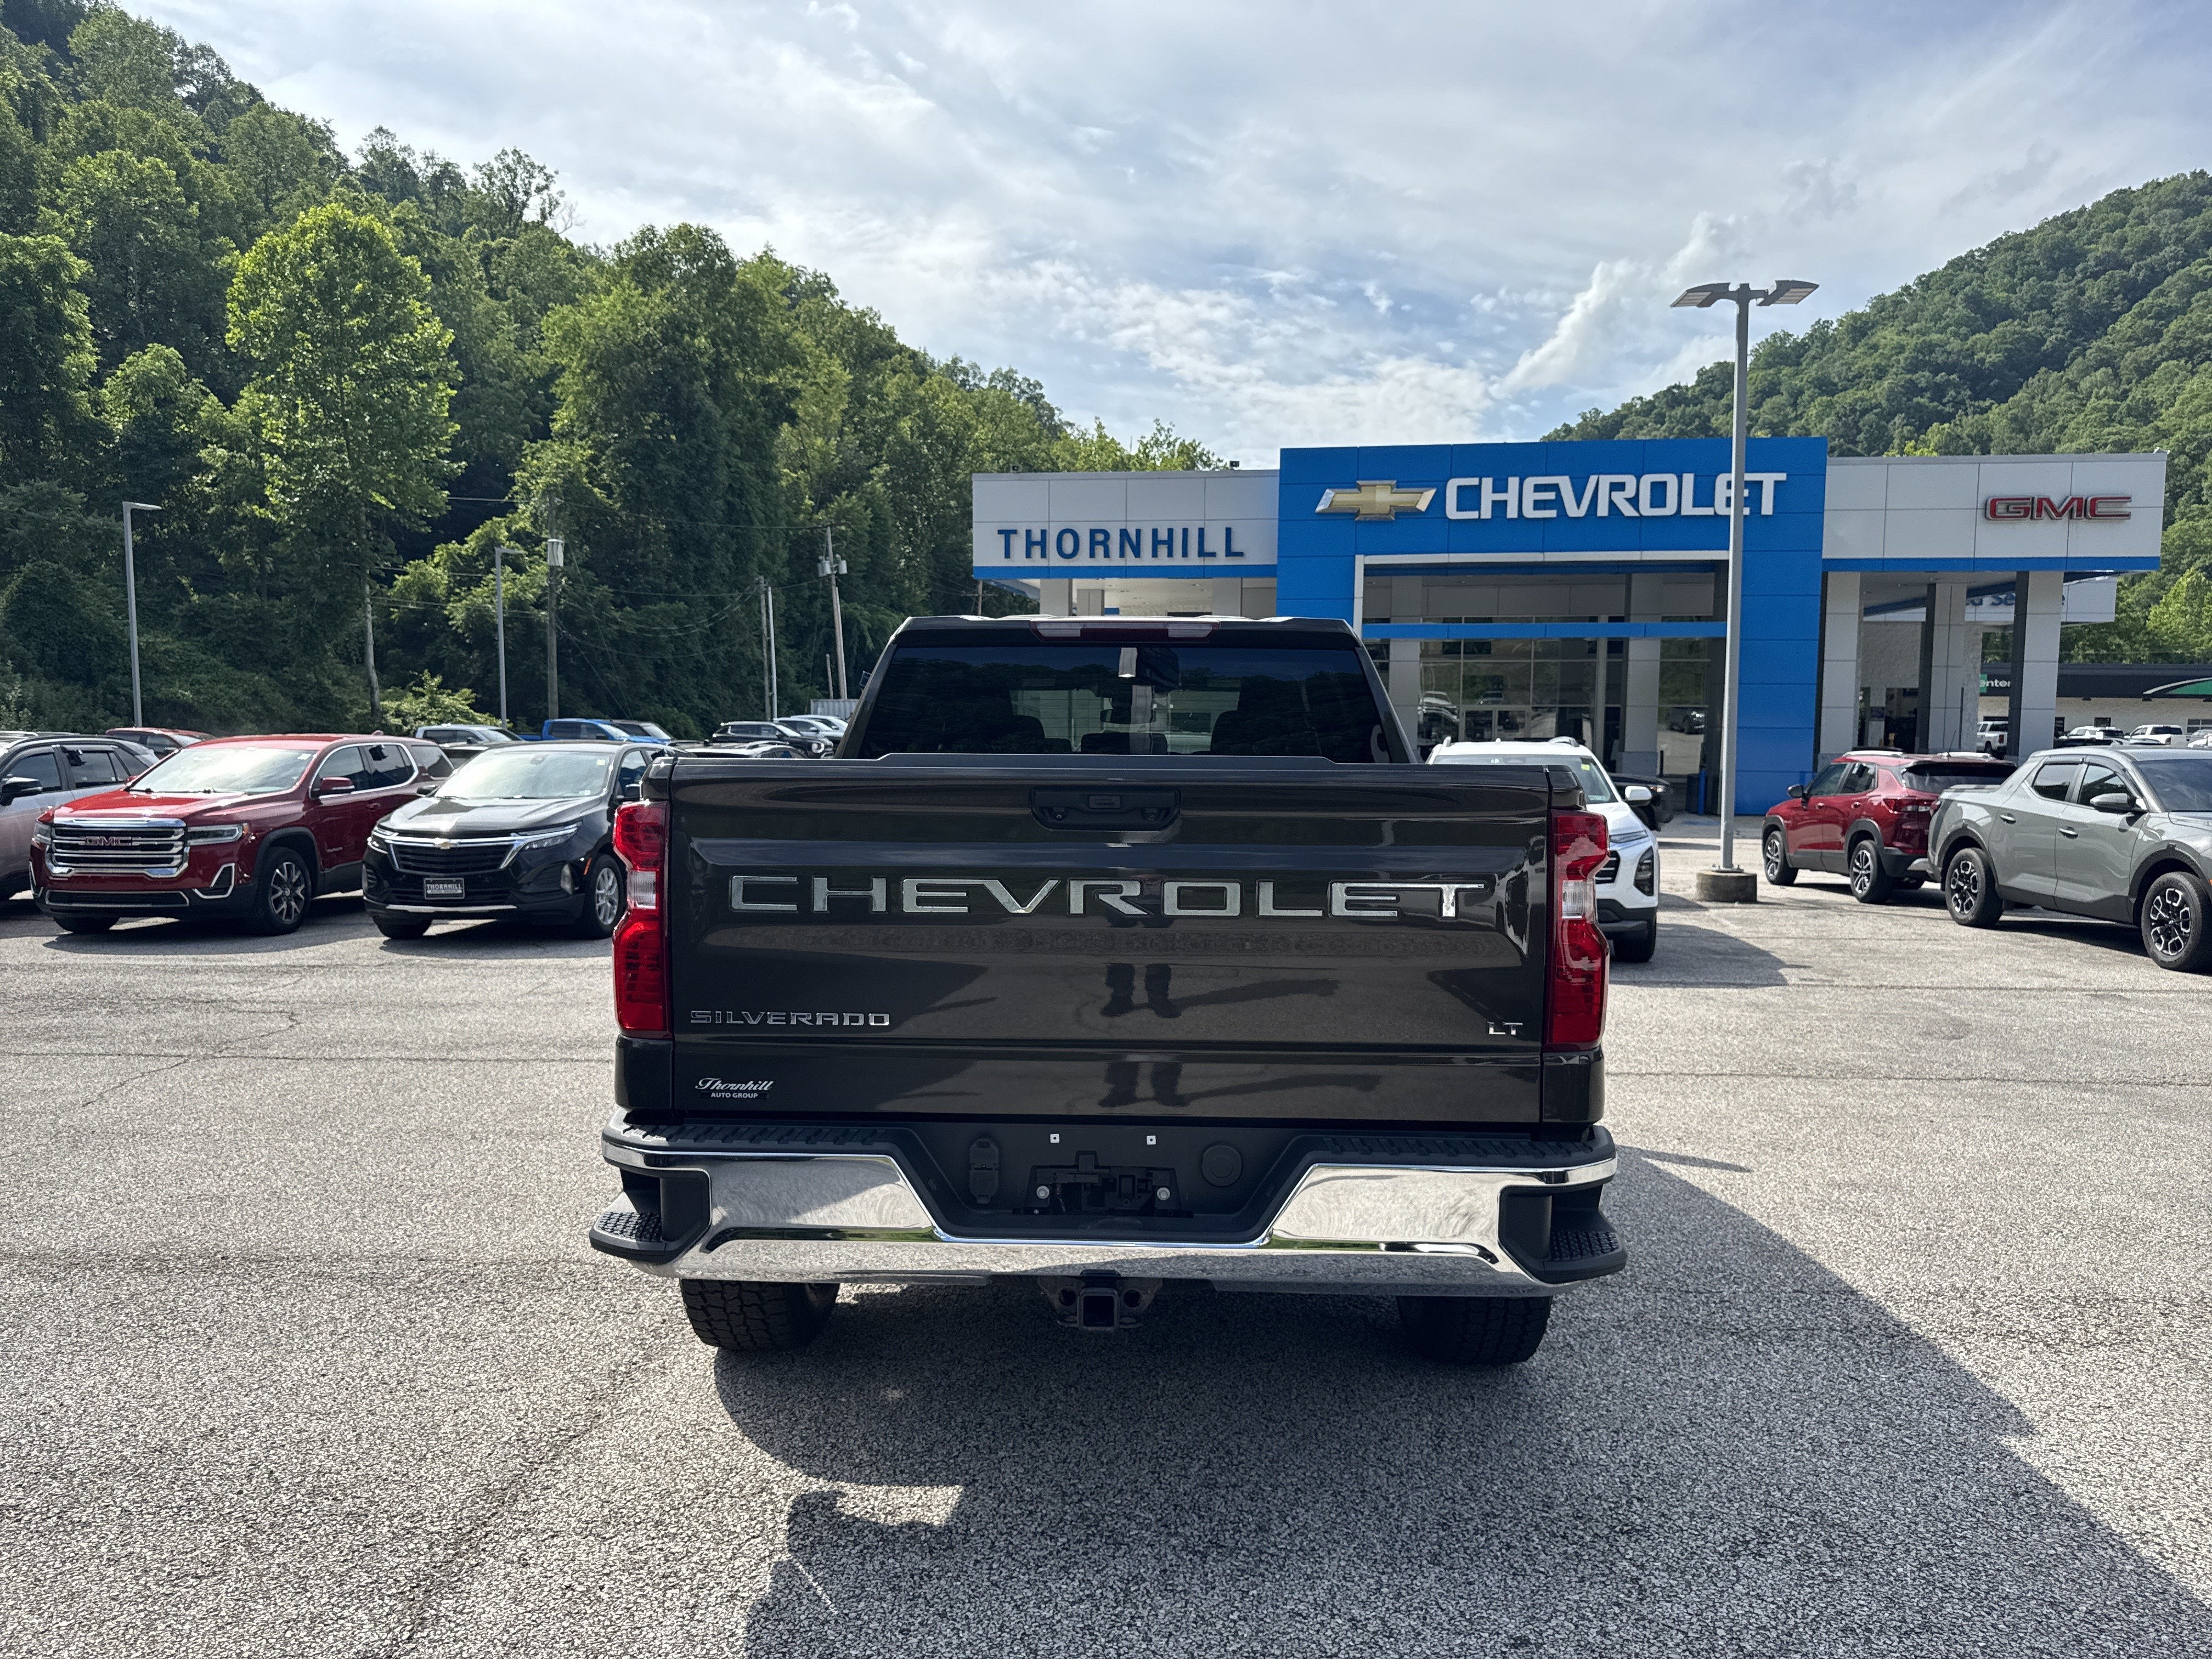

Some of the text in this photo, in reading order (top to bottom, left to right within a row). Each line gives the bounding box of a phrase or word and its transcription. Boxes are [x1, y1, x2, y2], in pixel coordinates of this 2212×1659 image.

[1445, 472, 1787, 520] CHEVROLET
[1985, 494, 2133, 520] GMC
[997, 527, 1245, 560] THORNHILL
[85, 836, 132, 846] GMC
[731, 875, 1486, 918] CHEVROLET
[690, 1010, 890, 1026] SILVERADO
[1487, 1021, 1523, 1035] LT
[695, 1077, 774, 1091] Thornhill
